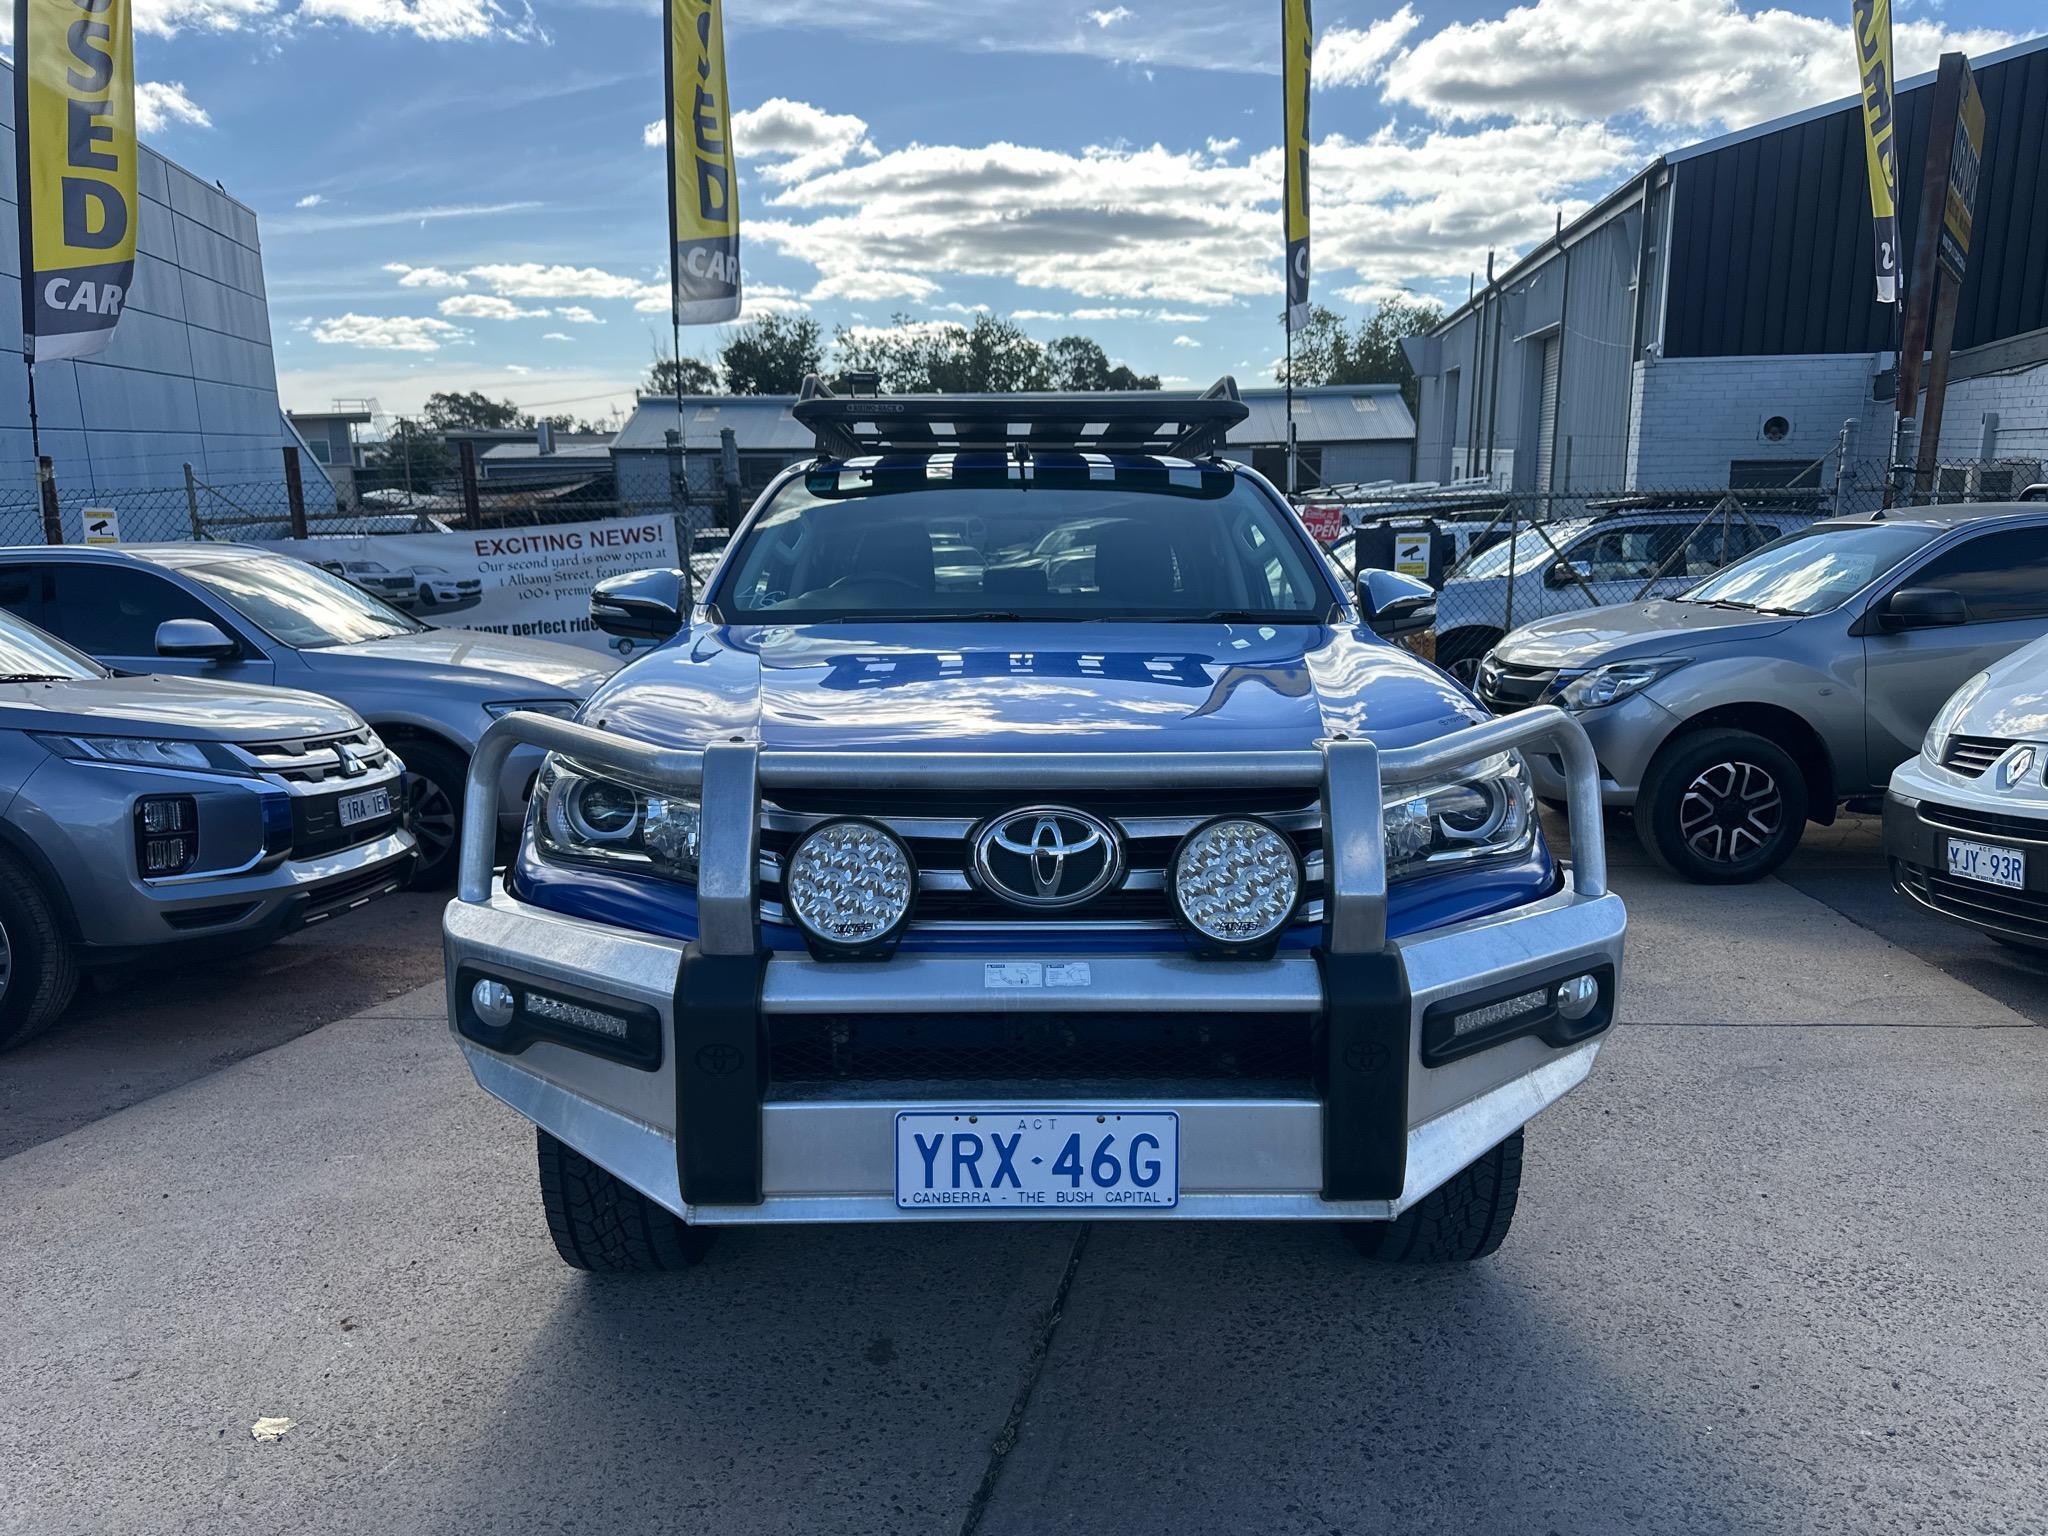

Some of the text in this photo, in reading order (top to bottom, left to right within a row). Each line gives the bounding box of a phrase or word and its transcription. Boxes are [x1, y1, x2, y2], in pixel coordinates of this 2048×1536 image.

[693, 0, 729, 223] SED
[62, 0, 128, 250] SED
[687, 246, 738, 286] CAR
[44, 277, 123, 315] CAR
[1305, 521, 1340, 538] OPEN
[475, 525, 663, 556] EXCITING NEWS!
[478, 548, 667, 574] Our second yard is now open at
[508, 572, 551, 588] Albany
[518, 585, 593, 600] 100+ premi
[512, 619, 567, 636] perfect
[1018, 1118, 1057, 1130] ACT
[912, 1191, 991, 1204] CANBERRA
[1017, 1191, 1046, 1204] THE
[1056, 1191, 1094, 1203] BUSH
[1105, 1191, 1161, 1203] CAPITAL
